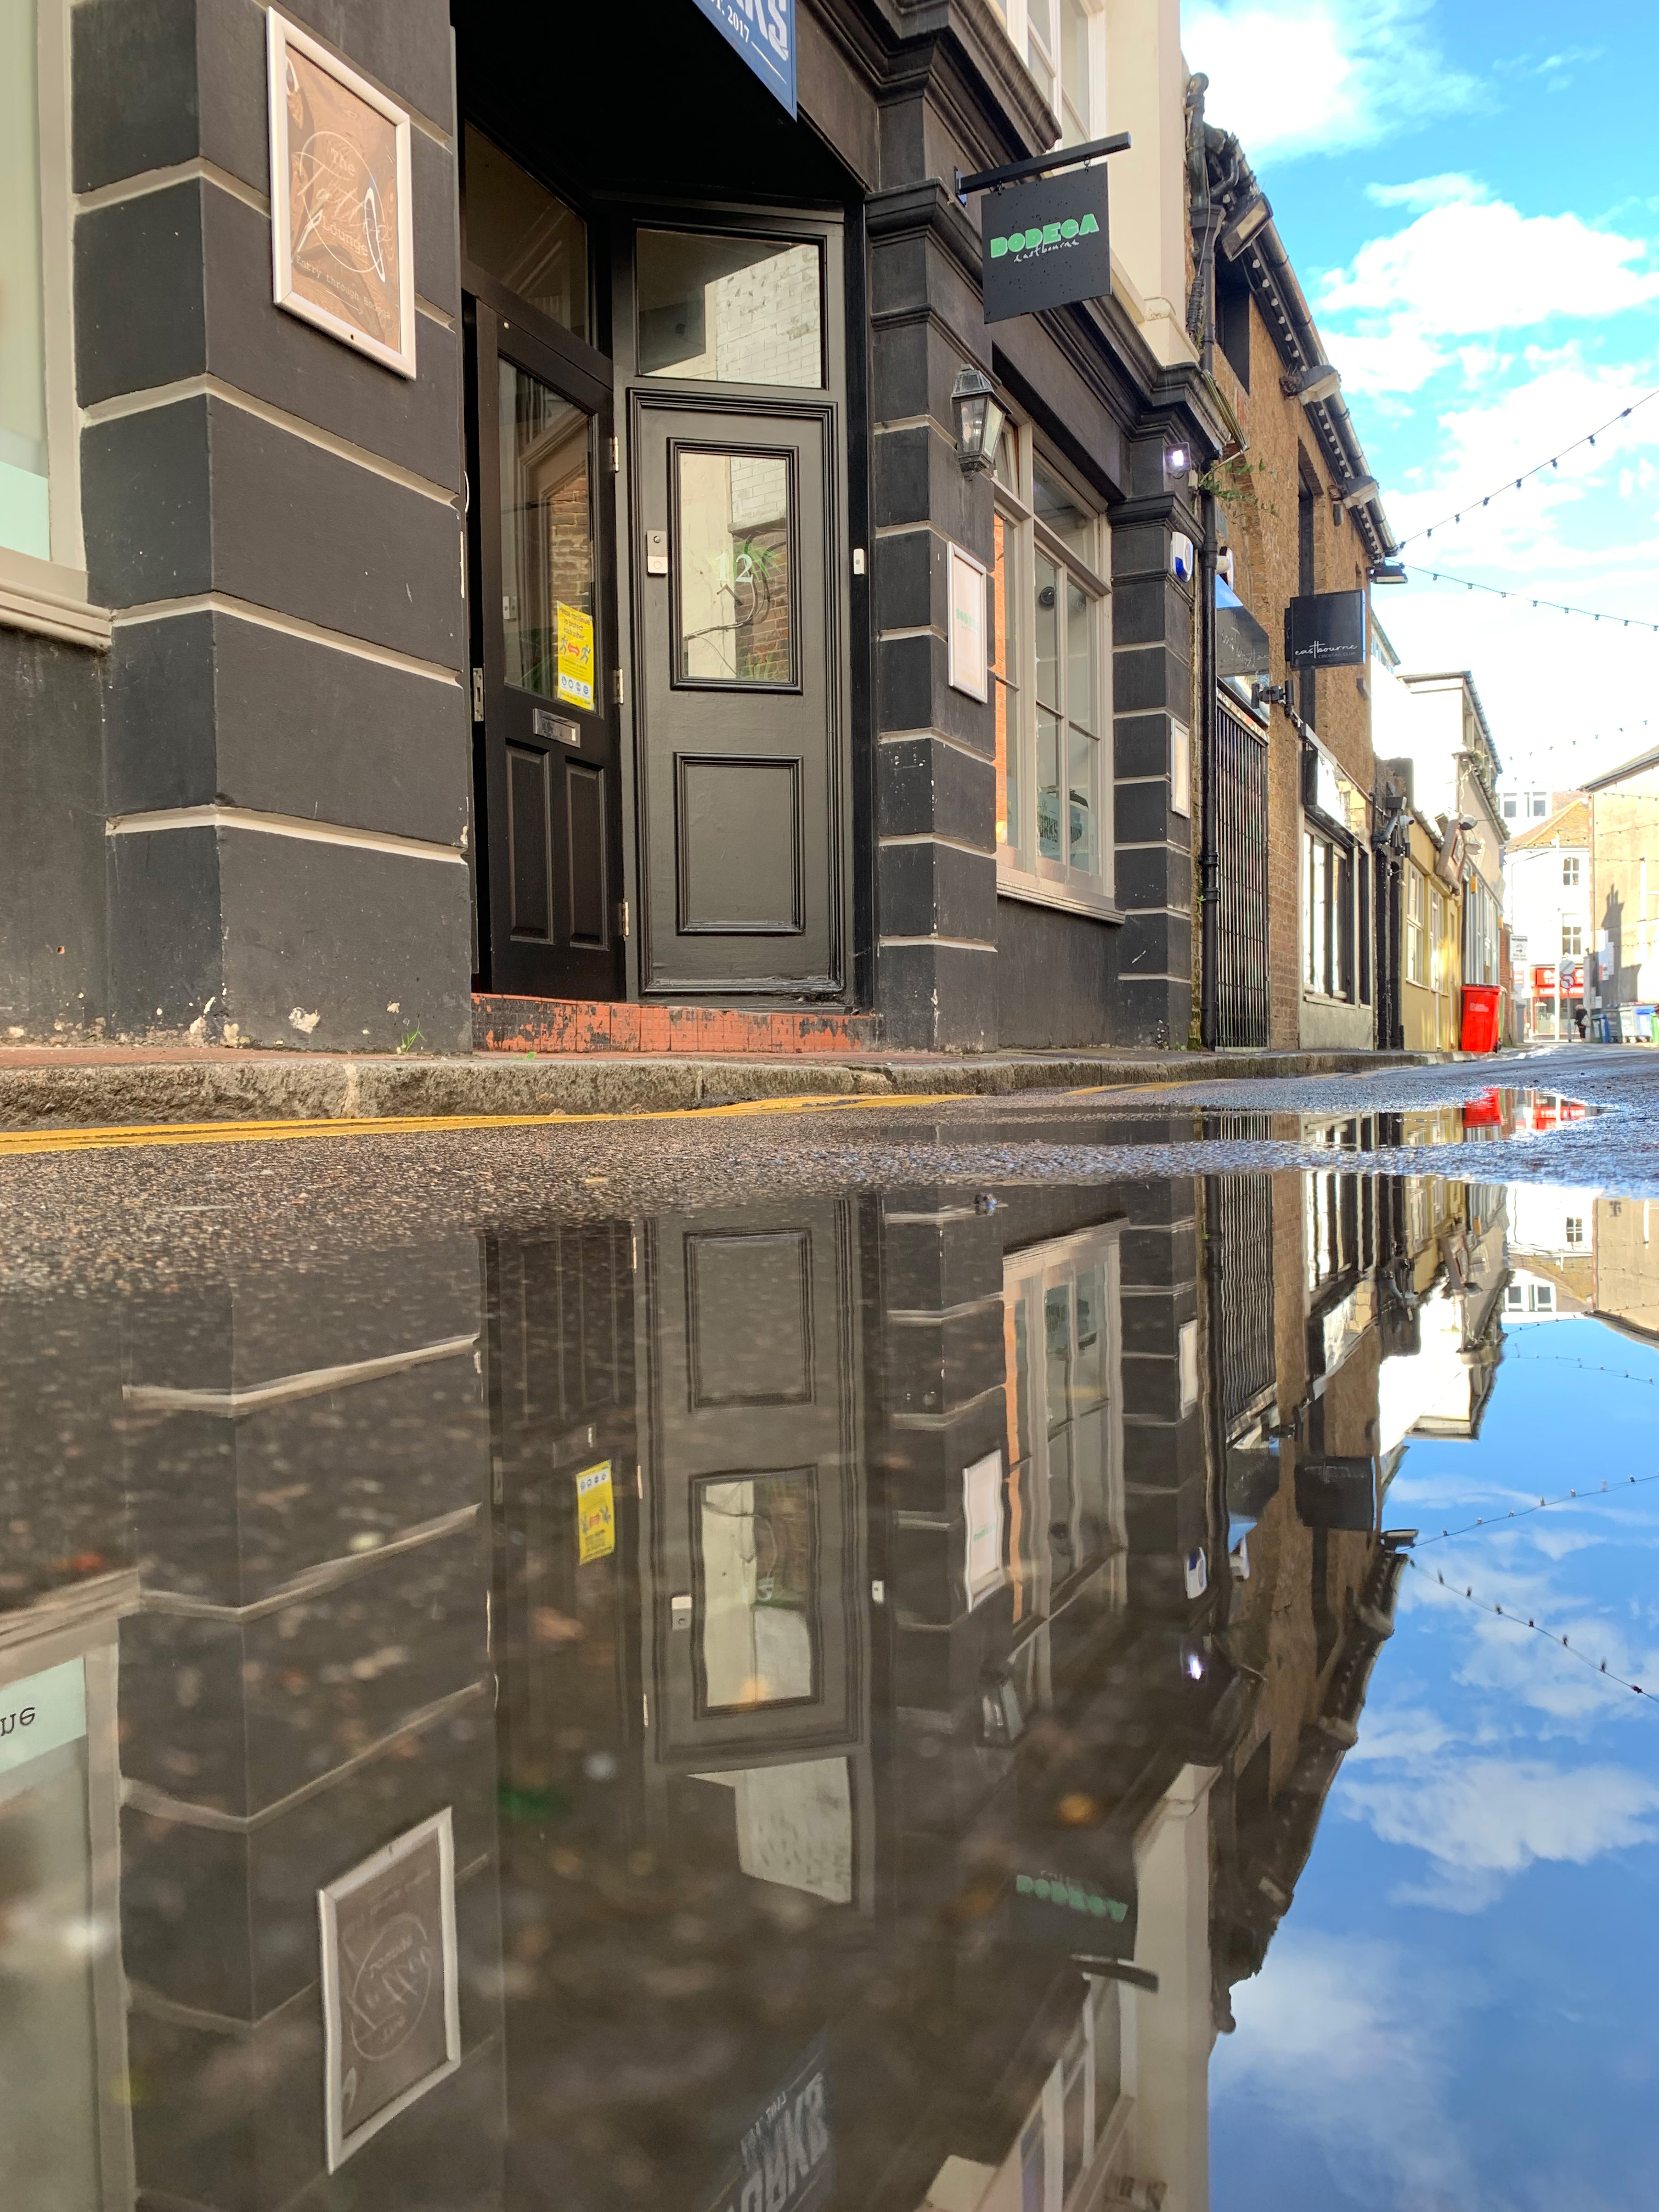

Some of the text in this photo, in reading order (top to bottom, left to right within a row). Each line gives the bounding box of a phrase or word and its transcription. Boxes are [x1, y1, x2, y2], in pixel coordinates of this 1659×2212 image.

[727, 4, 750, 43] 2017
[321, 215, 369, 257] Lounge
[990, 213, 1100, 259] BODEGA
[296, 255, 322, 279] Entry
[326, 273, 359, 301] through
[715, 552, 754, 583] 12
[1295, 640, 1358, 658] eastbourne
